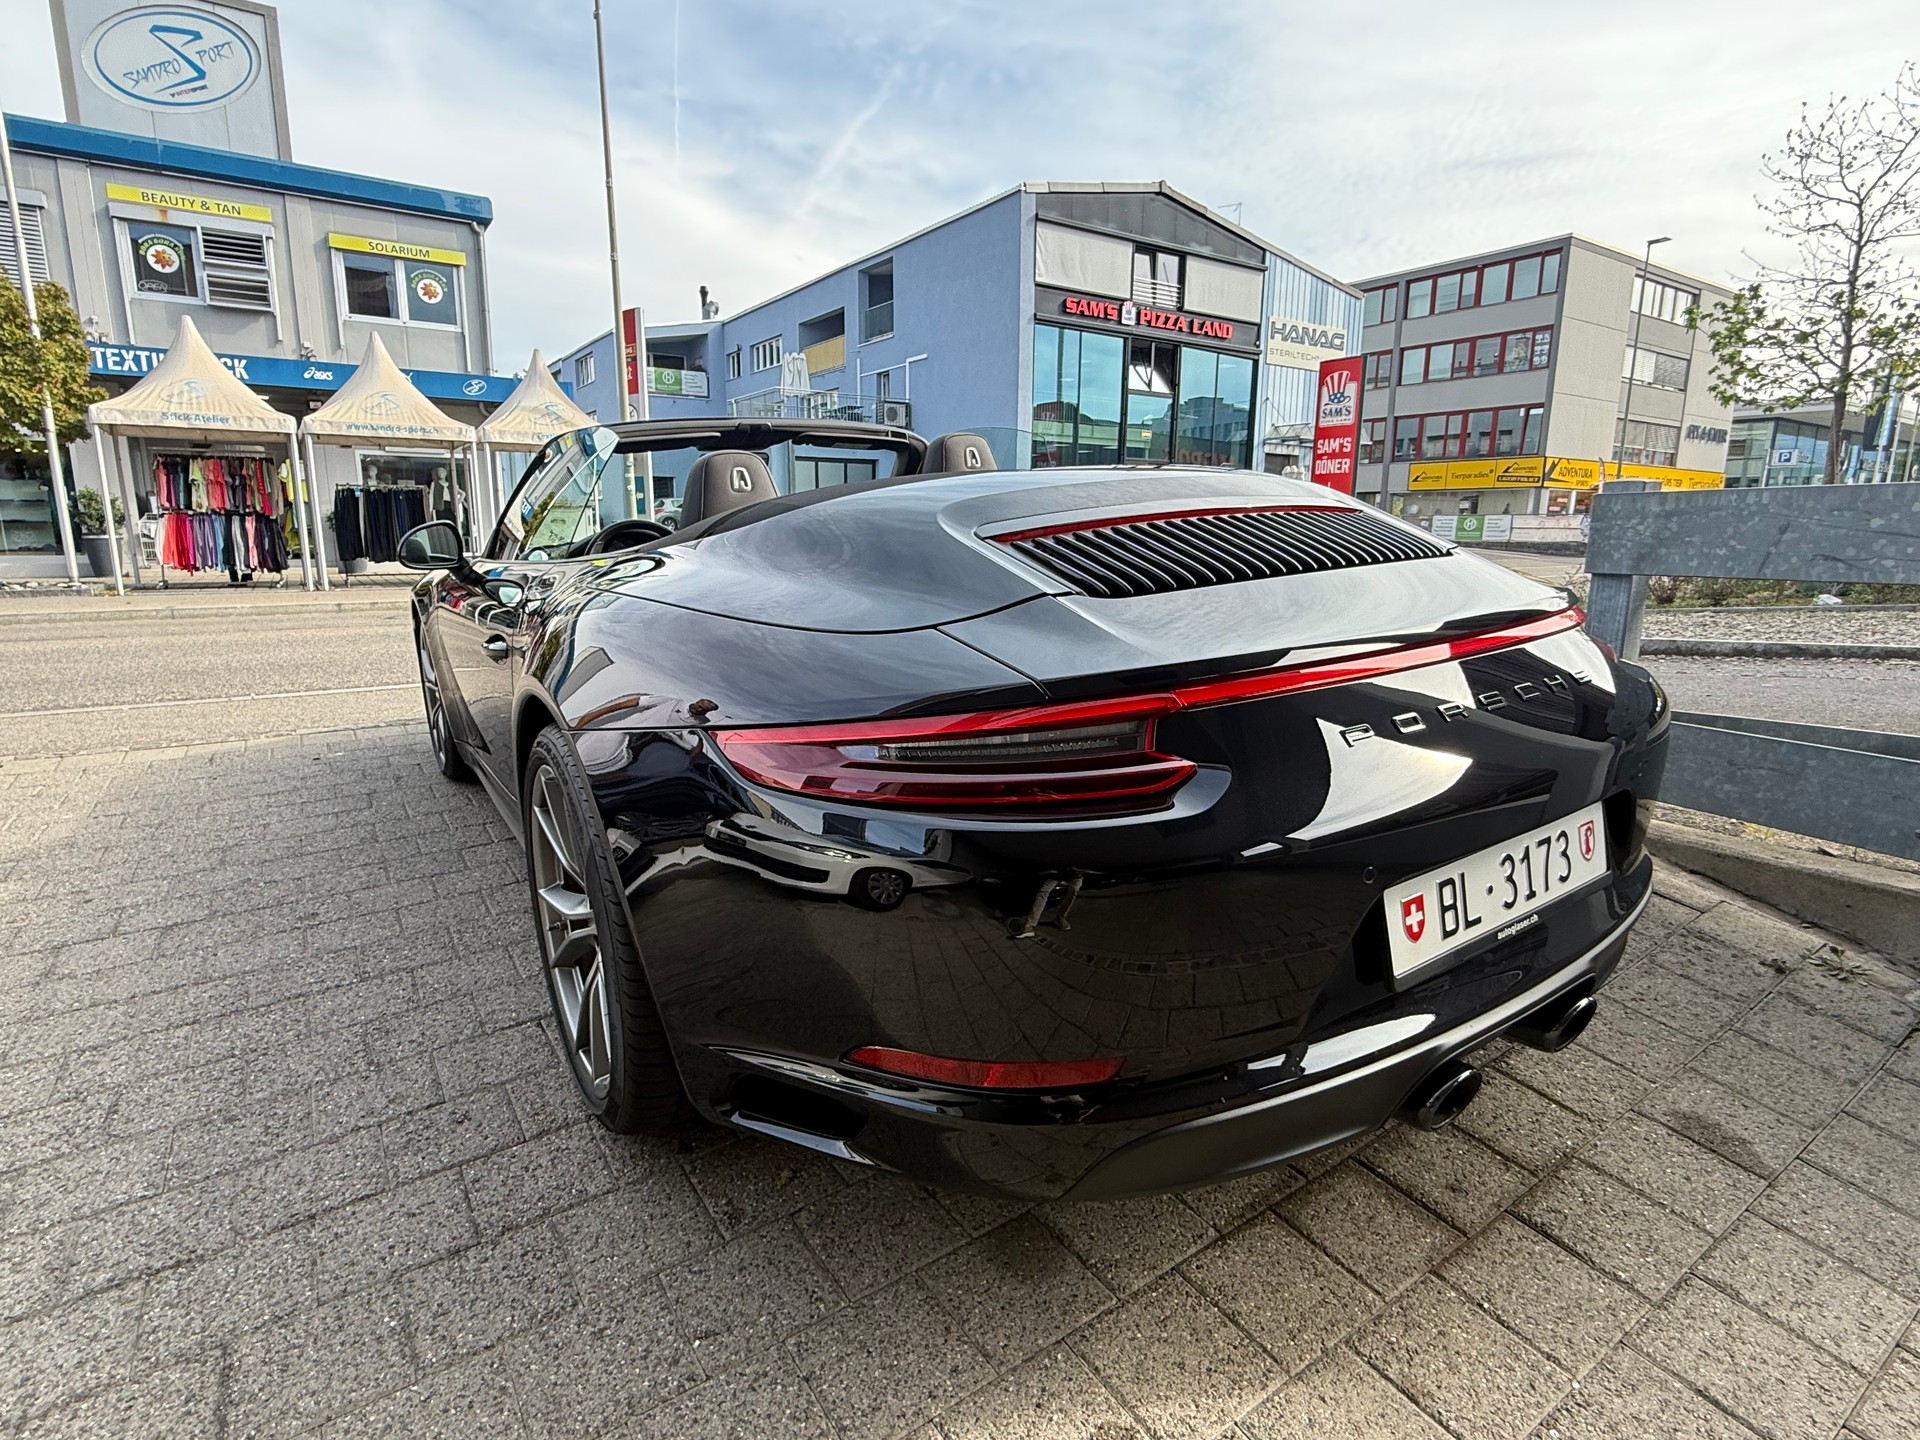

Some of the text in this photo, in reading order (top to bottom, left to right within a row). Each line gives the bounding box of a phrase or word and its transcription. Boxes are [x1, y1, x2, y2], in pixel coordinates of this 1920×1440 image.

[141, 191, 241, 216] BEAUTY & TAN
[368, 241, 430, 259] SOLARIUM
[1065, 297, 1234, 339] SAM'S PIZZA LAND
[1270, 321, 1345, 350] HANAG
[162, 411, 230, 425] Stick-Atelier
[1322, 405, 1352, 419] SAM'S
[1317, 437, 1352, 454] SAM'S
[1451, 471, 1489, 480] Tierparadies
[1558, 466, 1593, 479] ADVENTURA
[1339, 670, 1592, 748] PORSCHE
[1497, 913, 1539, 940] autoglaser.ch
